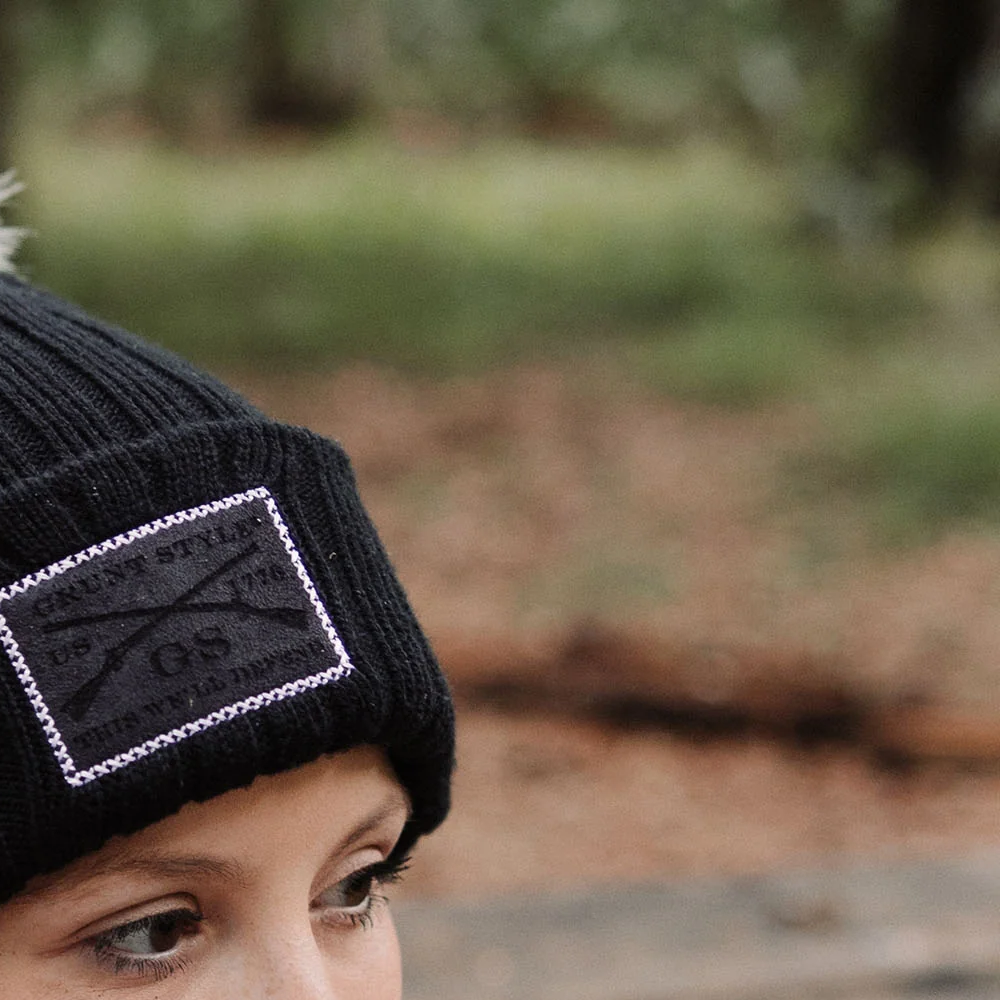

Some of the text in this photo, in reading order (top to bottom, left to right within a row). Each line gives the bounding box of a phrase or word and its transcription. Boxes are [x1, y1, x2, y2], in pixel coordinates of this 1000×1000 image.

[33, 519, 254, 618] GRUNT STYLE
[51, 635, 92, 666] US
[150, 627, 231, 678] GS
[73, 711, 140, 749] THIS
